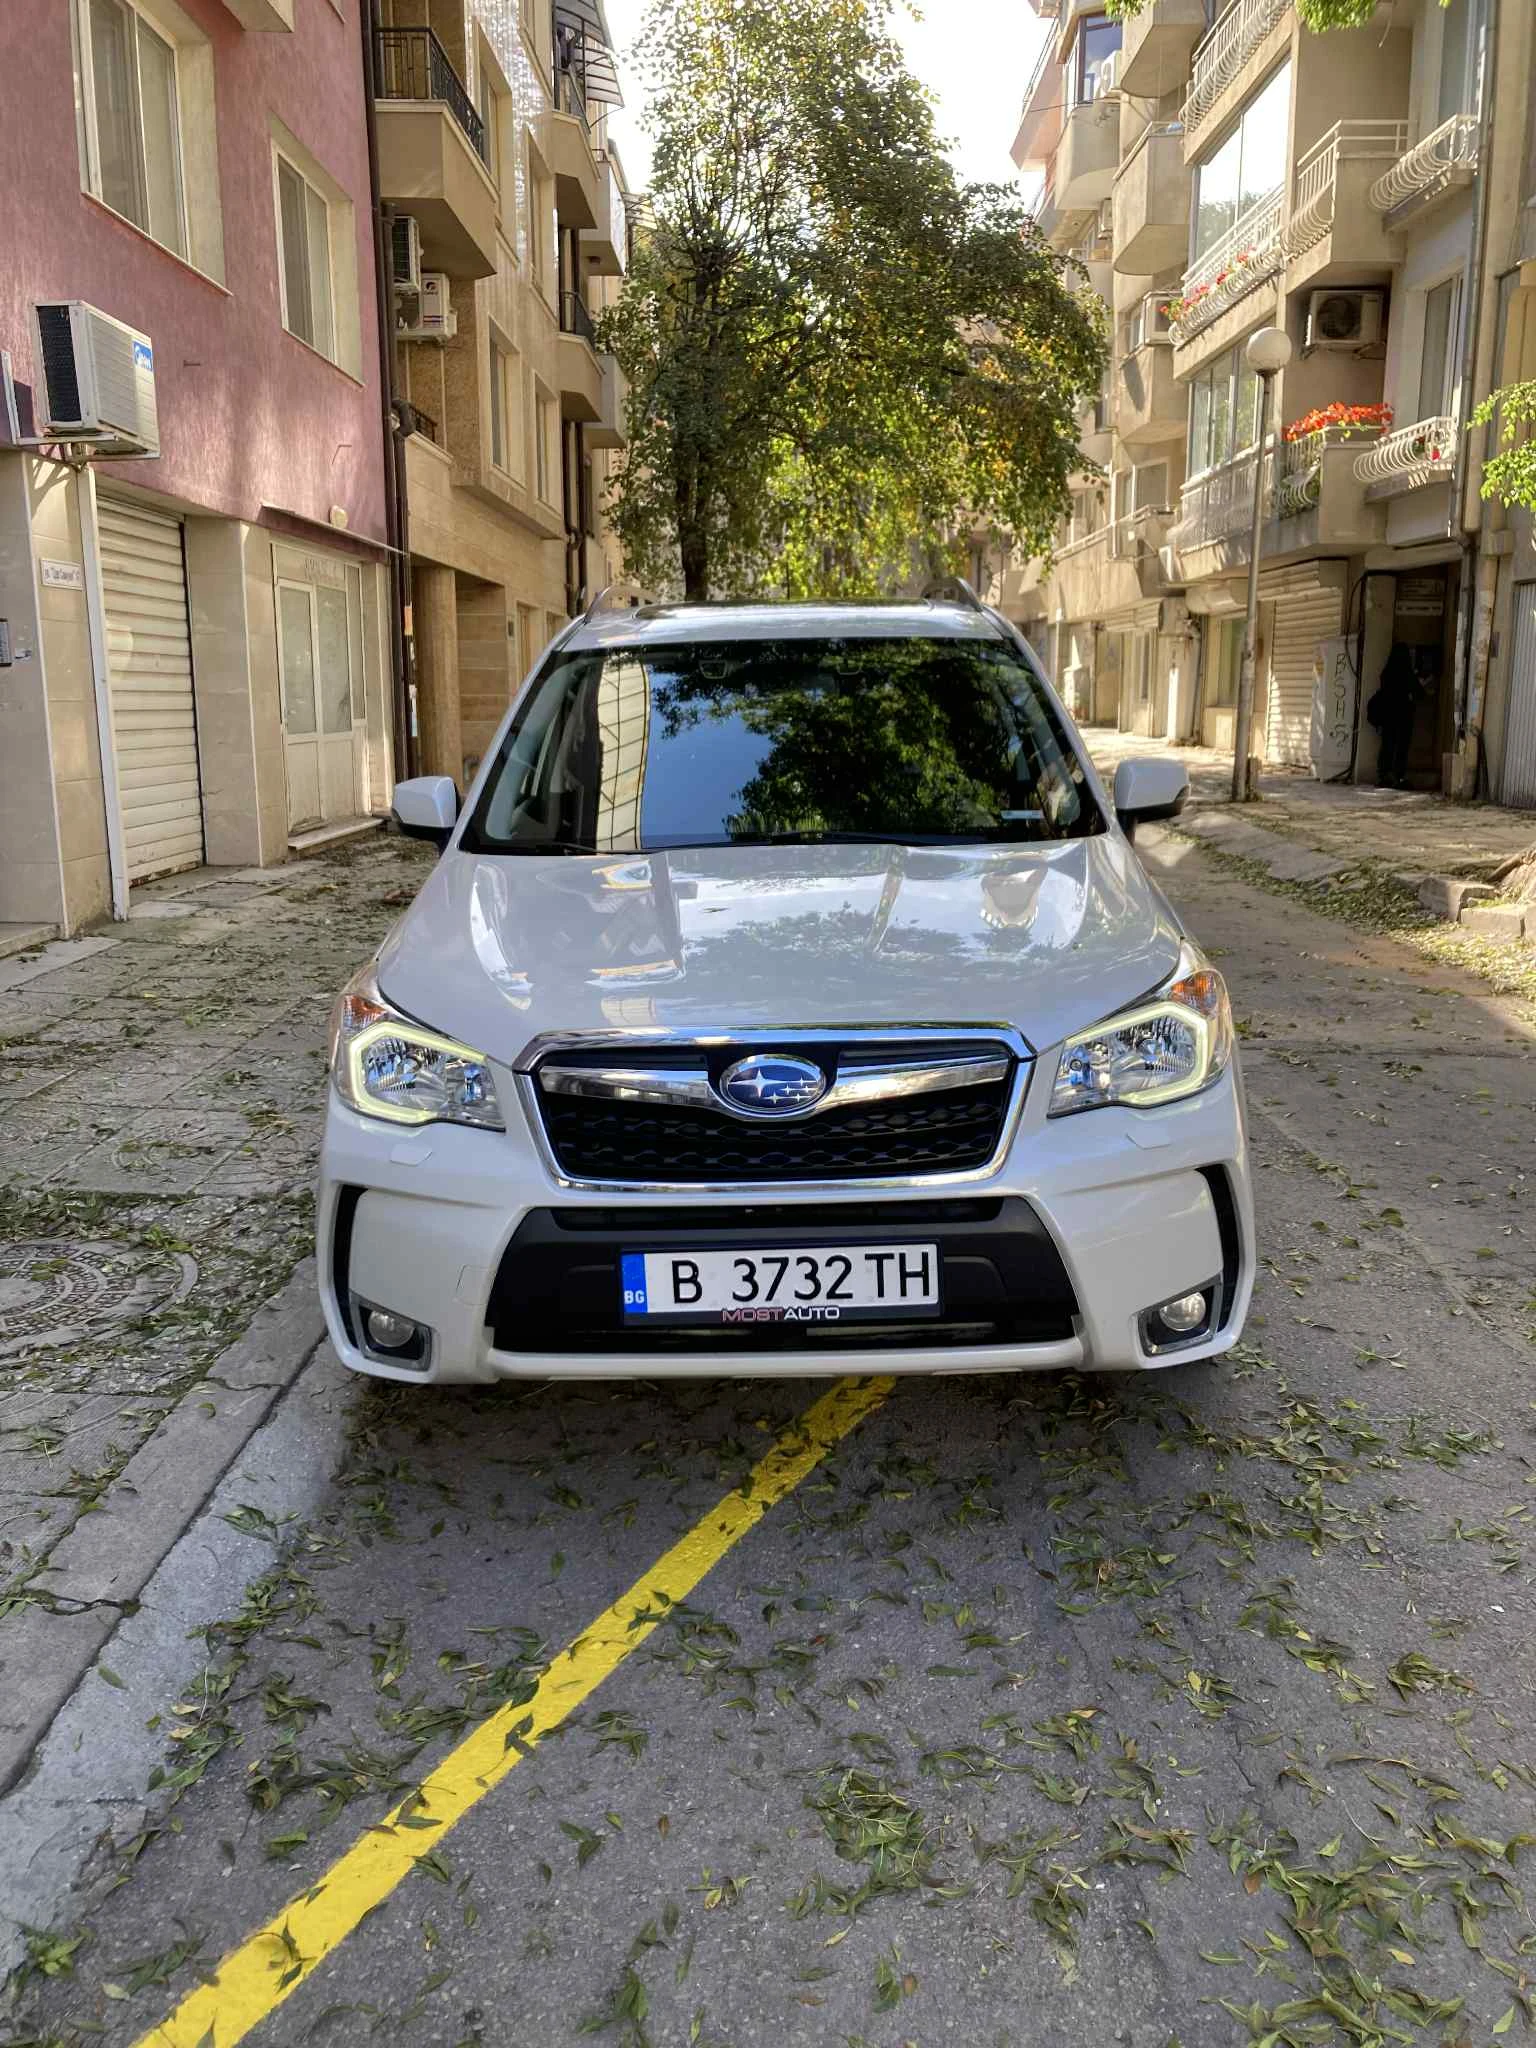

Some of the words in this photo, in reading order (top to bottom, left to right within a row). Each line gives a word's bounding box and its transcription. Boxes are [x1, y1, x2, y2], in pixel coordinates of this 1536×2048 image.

[624, 1290, 645, 1304] BG
[672, 1260, 703, 1304] B
[732, 1255, 853, 1302] 3732
[865, 1252, 930, 1298] TH
